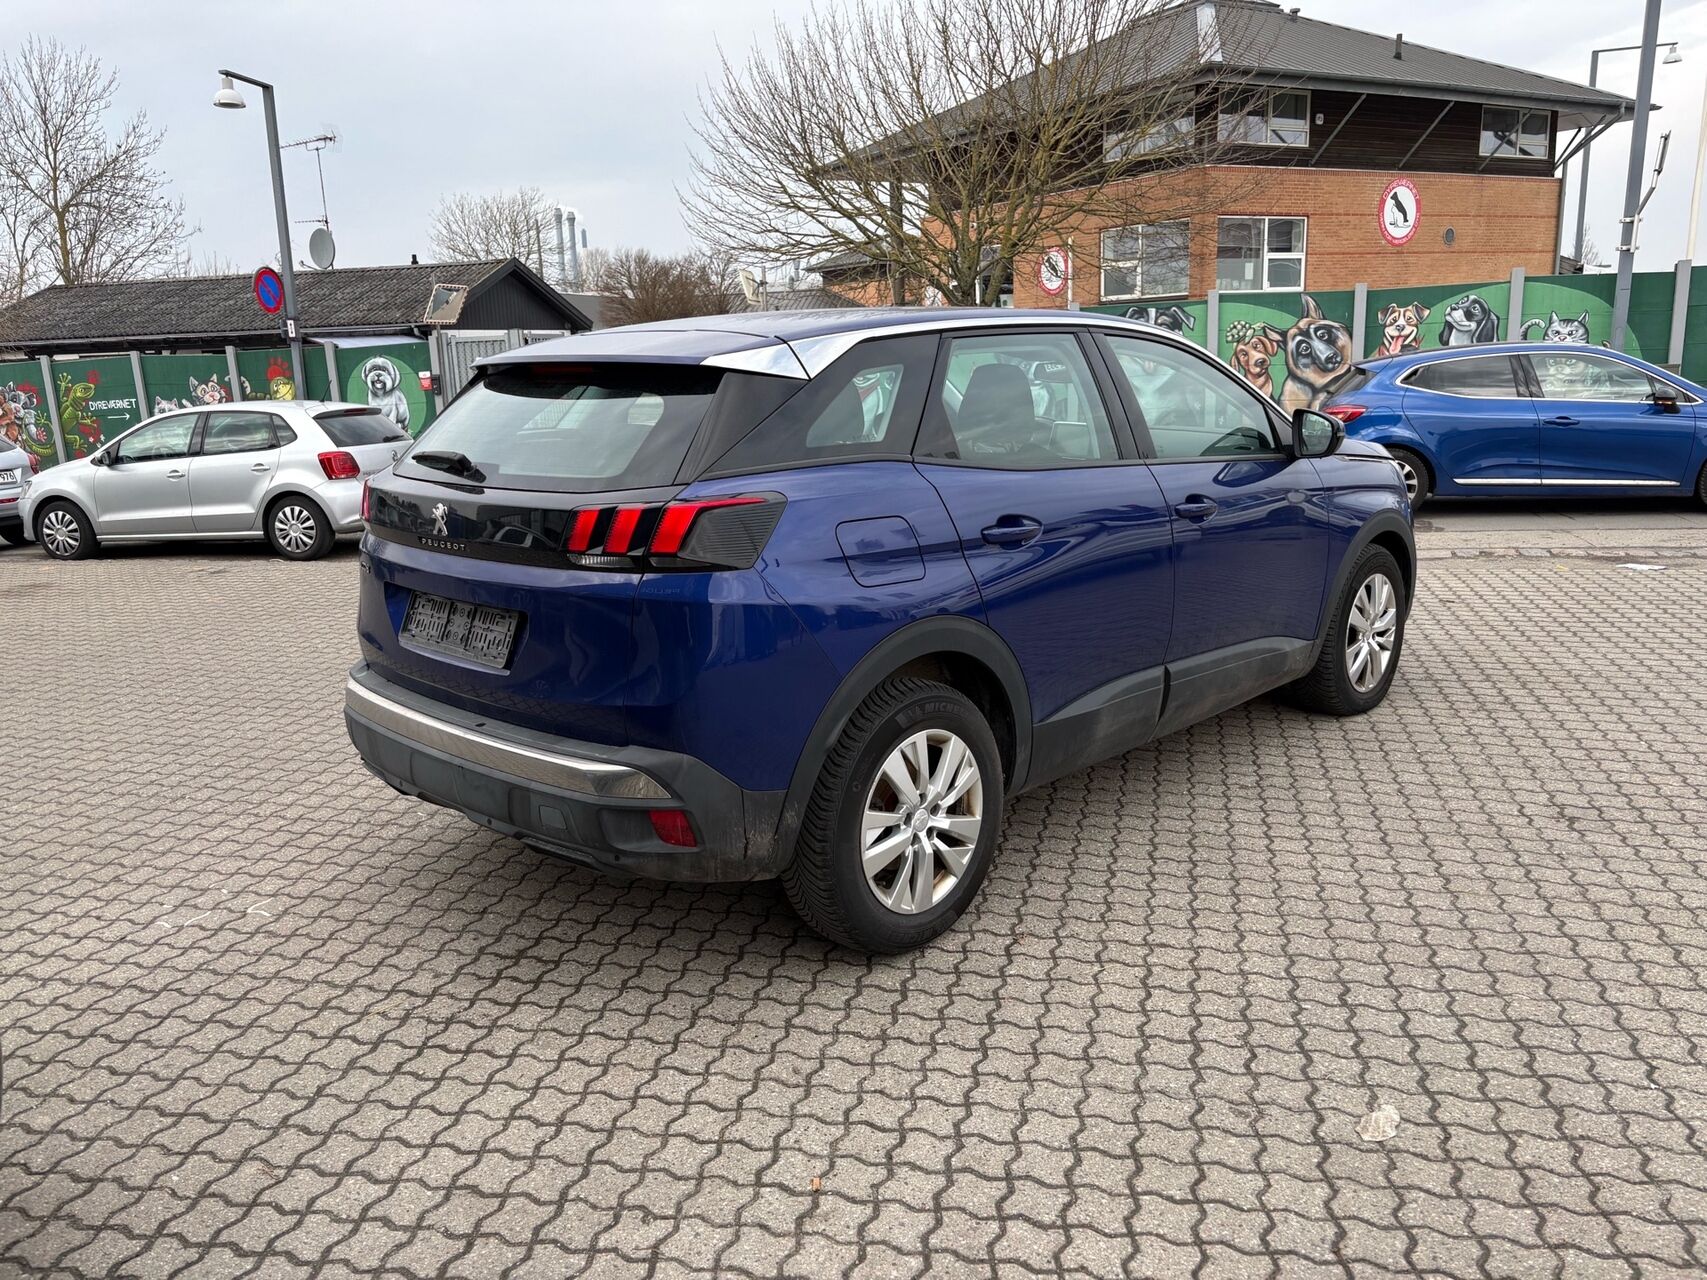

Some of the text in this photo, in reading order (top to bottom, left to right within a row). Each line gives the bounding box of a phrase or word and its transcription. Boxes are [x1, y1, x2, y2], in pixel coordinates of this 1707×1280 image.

[88, 398, 137, 410] DYREVÆRNET
[421, 538, 465, 551] PEUGEOT
[924, 702, 968, 716] MICHE
